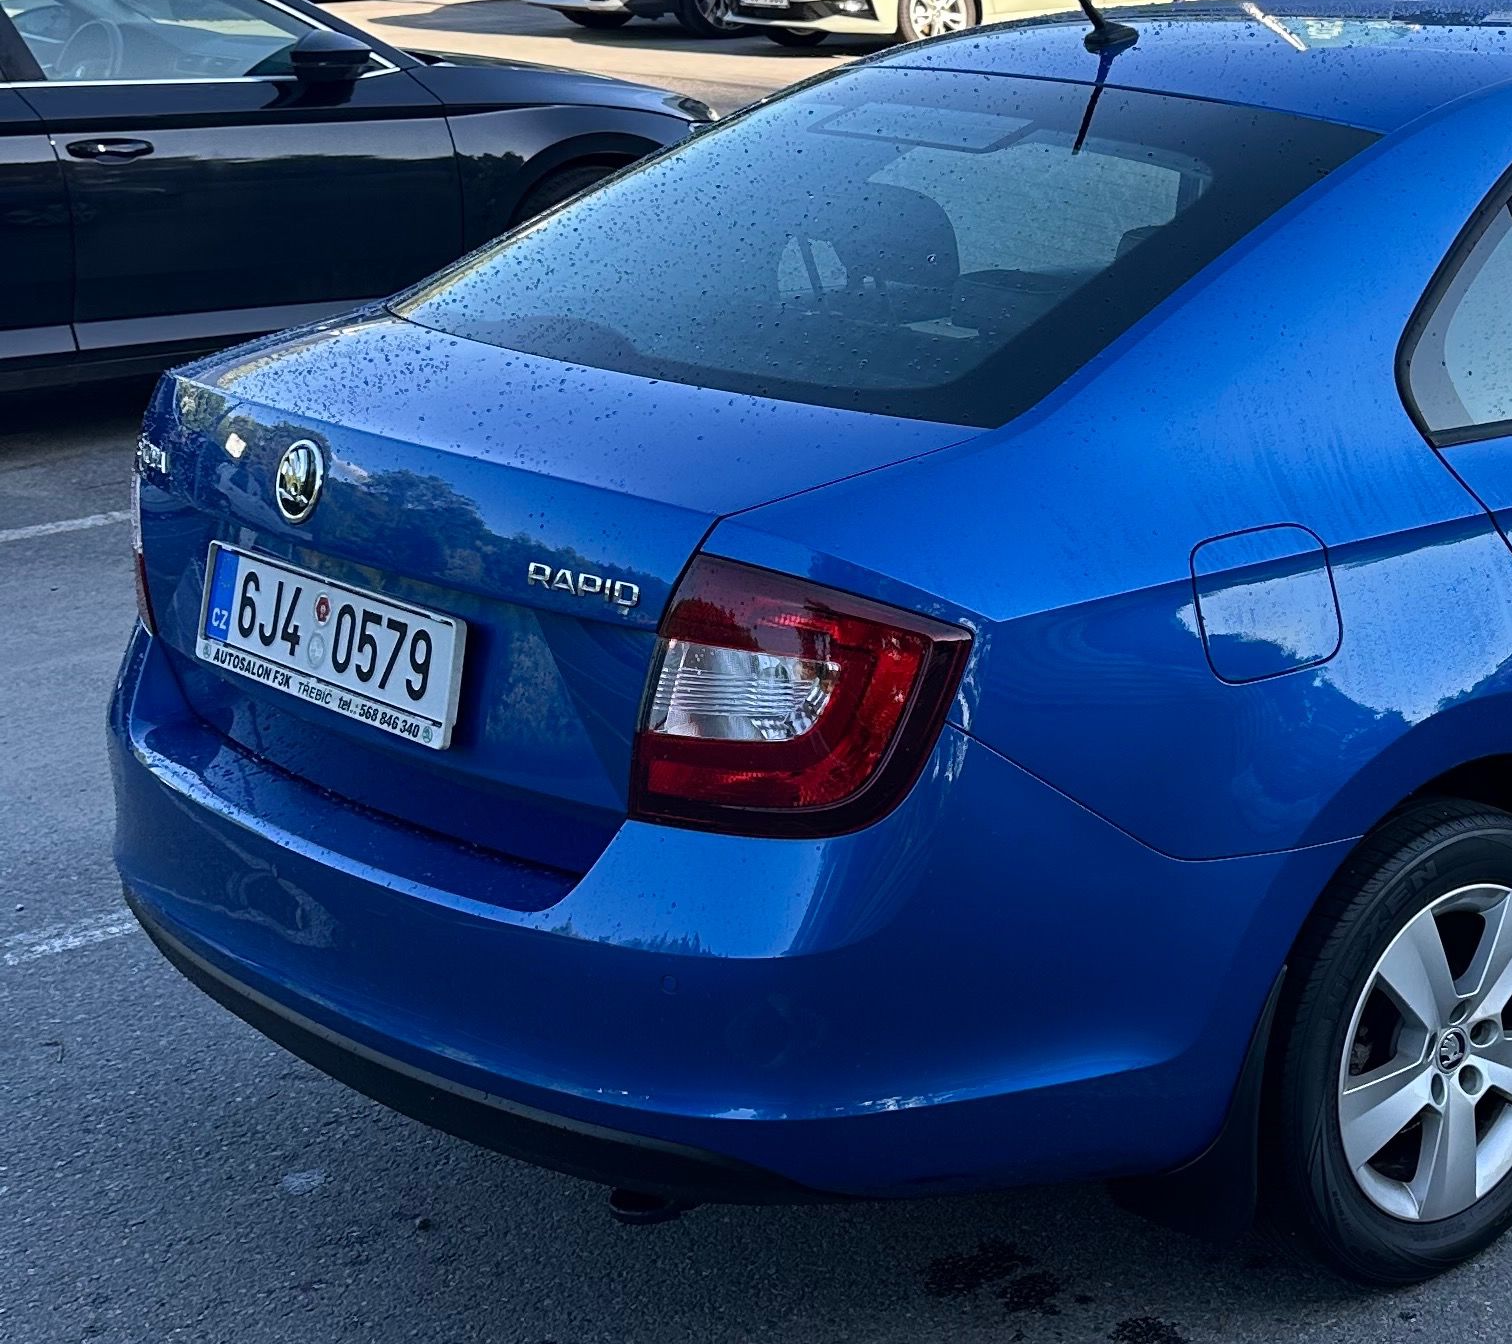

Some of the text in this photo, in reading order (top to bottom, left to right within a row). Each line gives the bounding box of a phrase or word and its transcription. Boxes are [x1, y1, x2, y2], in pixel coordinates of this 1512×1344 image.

[212, 607, 228, 631] CZ
[237, 571, 433, 701] 6J4 0579
[213, 647, 272, 681] AUTOSALON
[272, 669, 293, 689] F3K
[298, 680, 333, 704] TŘEBÍČ
[358, 703, 379, 722] 568
[379, 711, 400, 730] 846
[399, 719, 420, 738] 340
